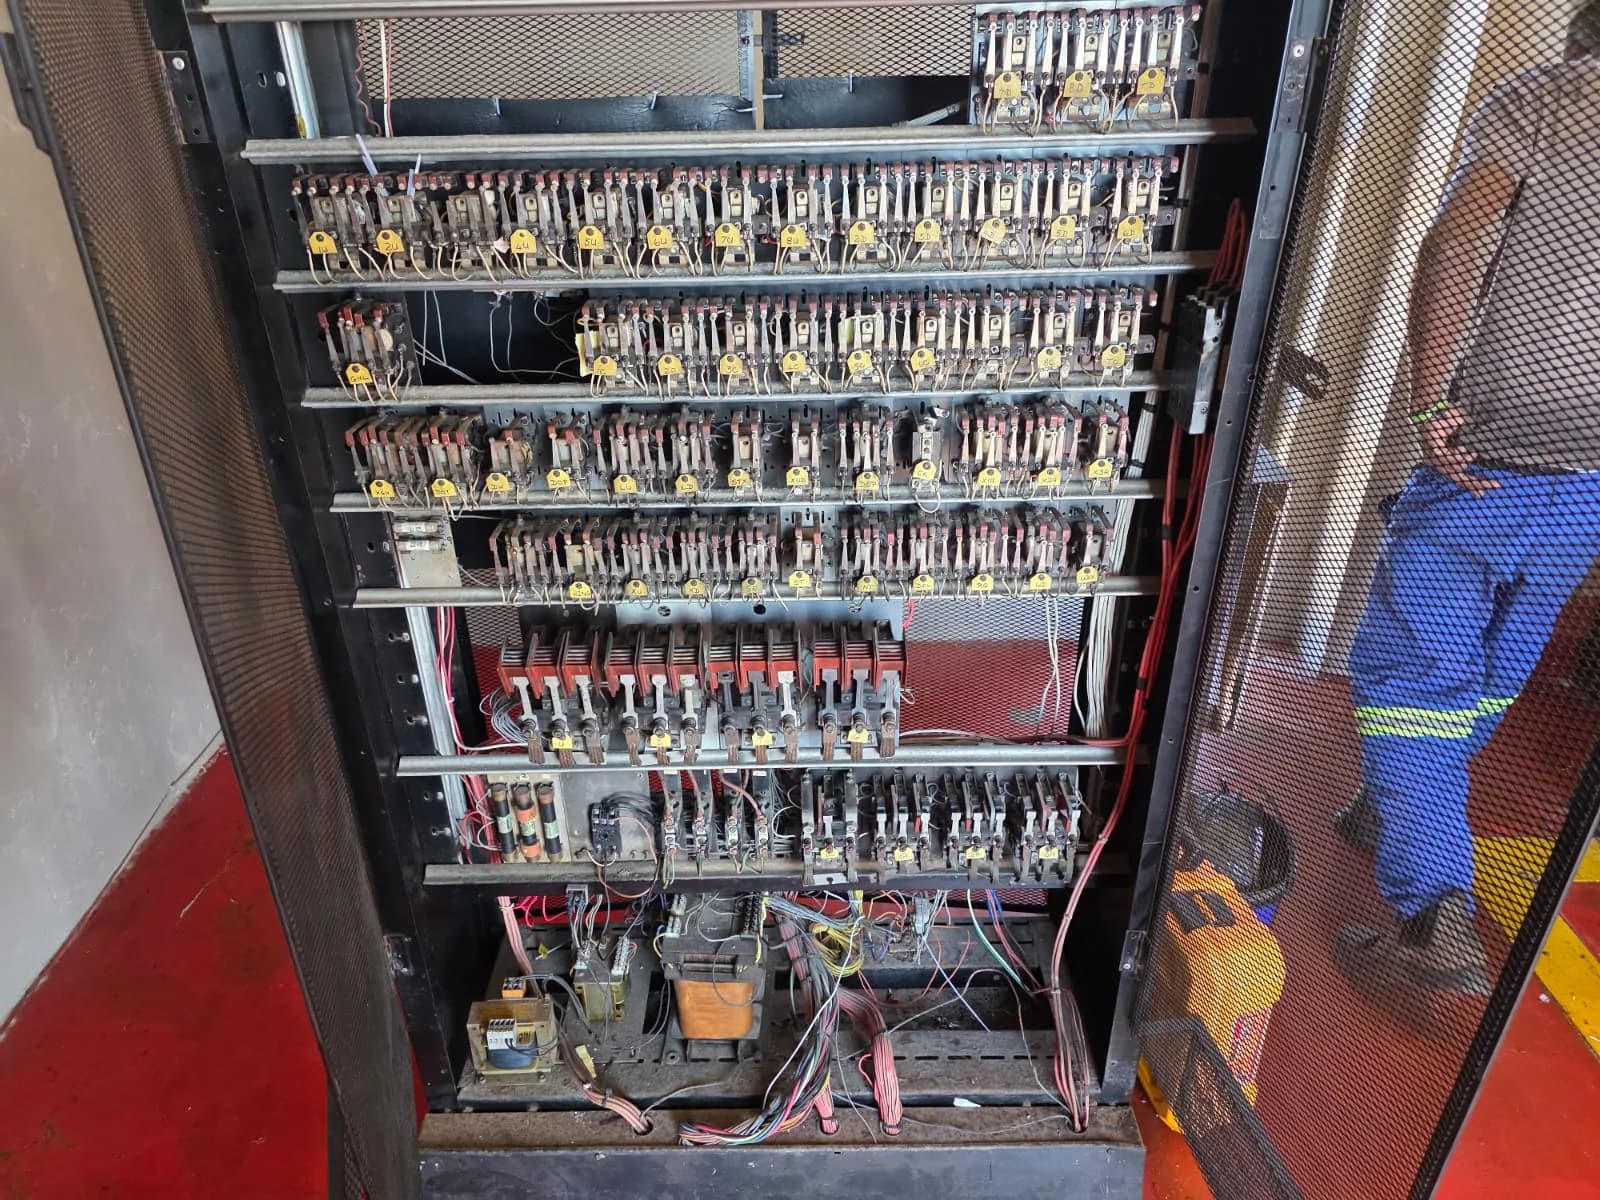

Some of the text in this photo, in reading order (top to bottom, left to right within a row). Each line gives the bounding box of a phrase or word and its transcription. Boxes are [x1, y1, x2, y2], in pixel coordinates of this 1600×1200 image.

[584, 238, 597, 246] 5U
[720, 235, 734, 244] 7U
[384, 242, 399, 251] 2U
